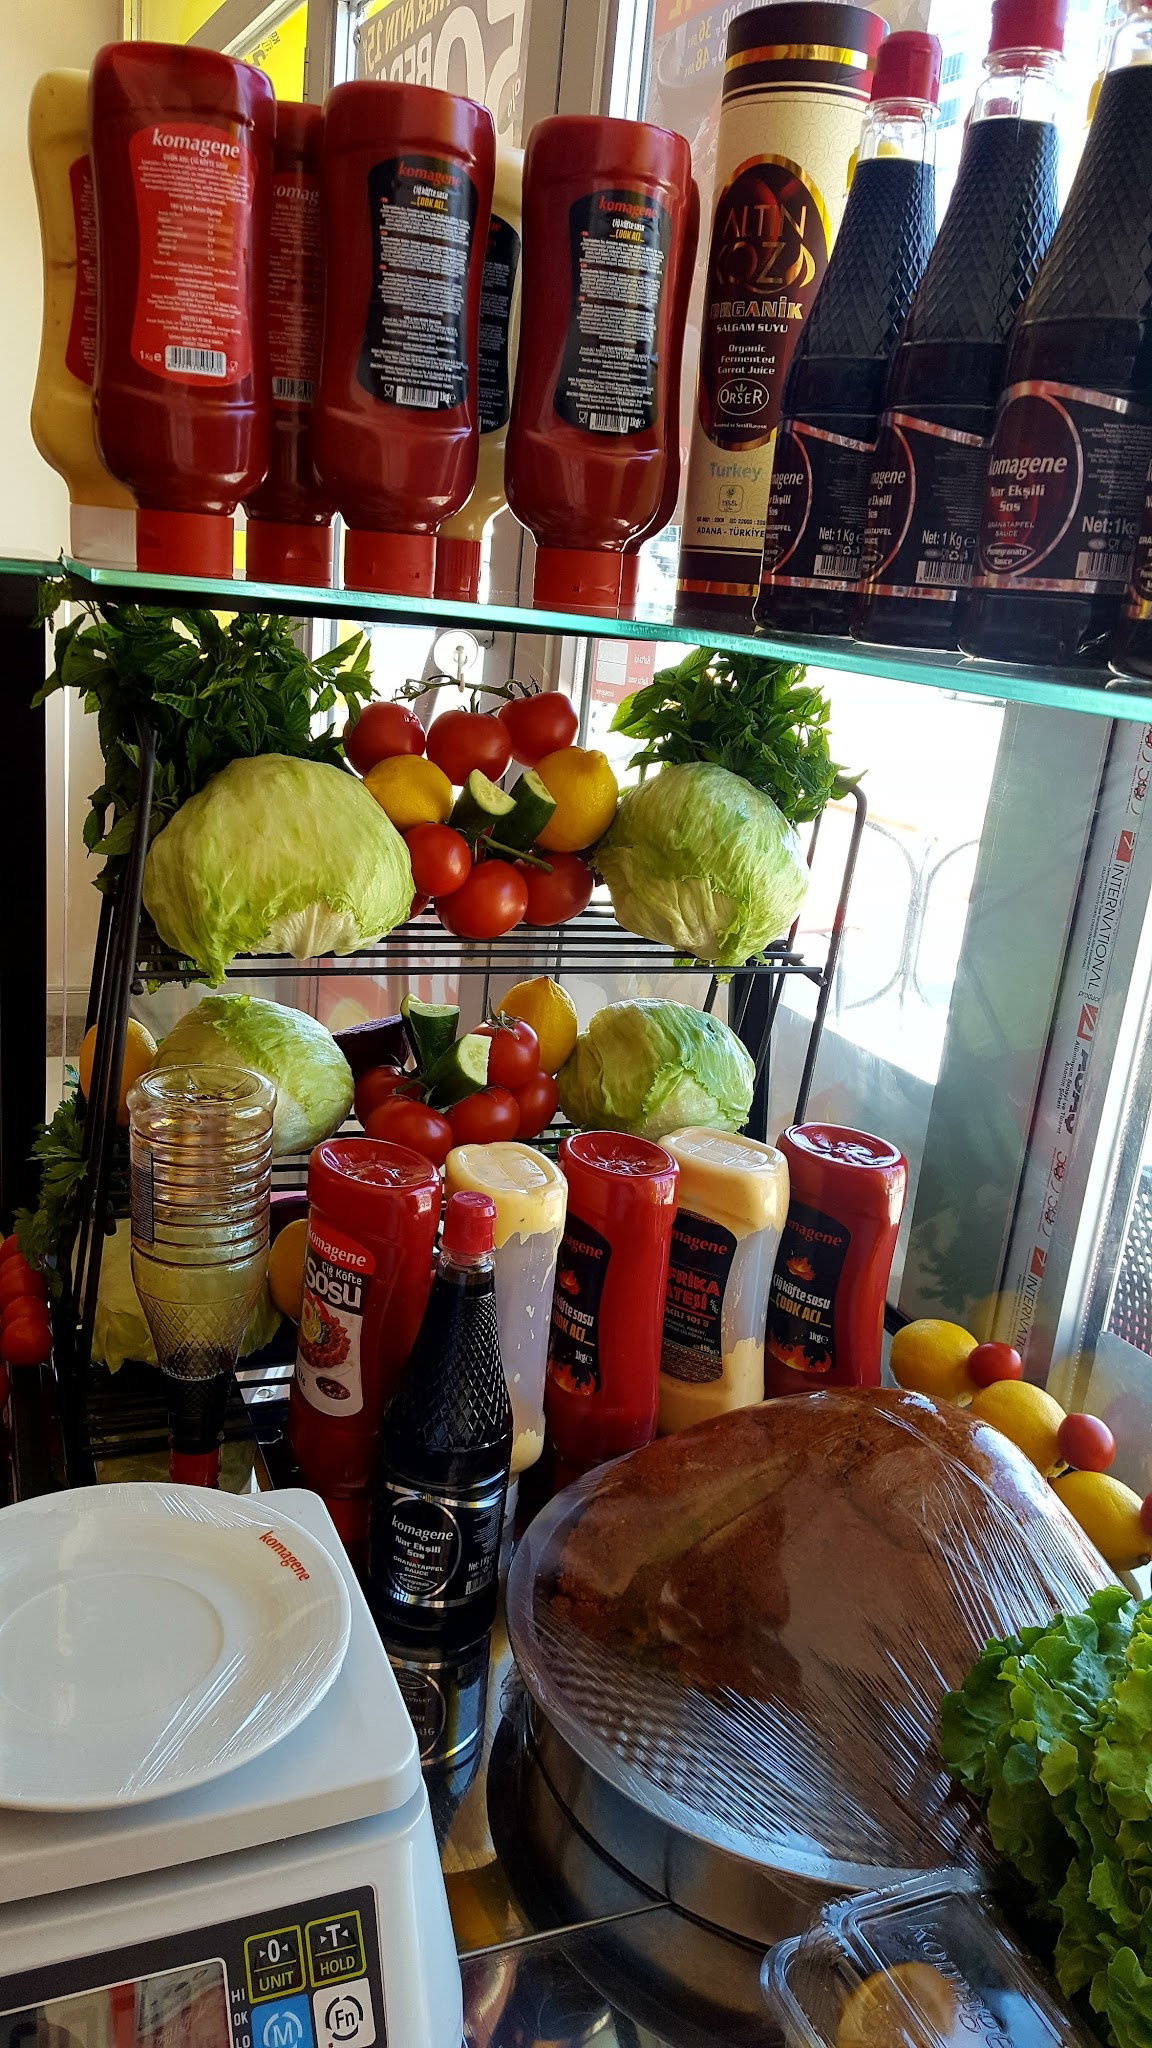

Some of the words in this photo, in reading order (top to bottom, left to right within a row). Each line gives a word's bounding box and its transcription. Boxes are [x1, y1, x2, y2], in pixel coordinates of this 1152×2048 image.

[152, 127, 240, 158] komagene
[399, 161, 461, 187] komagene
[598, 194, 658, 219] komagene
[711, 296, 803, 320] ORGANİK
[716, 323, 755, 334] ŞALGAM
[757, 323, 789, 333] SUYU
[728, 344, 767, 354] Organic
[720, 355, 775, 364] Fermented
[718, 366, 745, 374] Carrot
[747, 366, 775, 375] Juice
[710, 462, 762, 482] Turkey
[1008, 484, 1045, 499] Ekşili
[1000, 500, 1021, 512] Sos
[697, 526, 722, 536] ADANA
[729, 527, 765, 538] TÜRKİYE
[819, 527, 836, 541] Net:
[843, 529, 855, 545] Kg
[922, 530, 940, 545] Net:
[949, 531, 963, 549] Kg
[1088, 863, 1125, 990] INTERNATIONAL
[672, 1230, 728, 1255] magene
[335, 1269, 363, 1286] Köfte
[391, 1515, 454, 1541] komagene
[395, 1535, 412, 1547] Nar
[259, 1530, 310, 1581] komagene
[406, 1549, 425, 1559] Sos
[404, 1566, 429, 1577] SAUCE
[326, 1923, 341, 1947] T
[320, 1956, 356, 1976] HOLD
[259, 1971, 294, 1992] UNIT
[231, 1988, 246, 2004] HI
[233, 2011, 249, 2027] OK
[335, 2009, 355, 2030] Fn
[236, 2035, 250, 2048] LO
[273, 2021, 293, 2048] M
